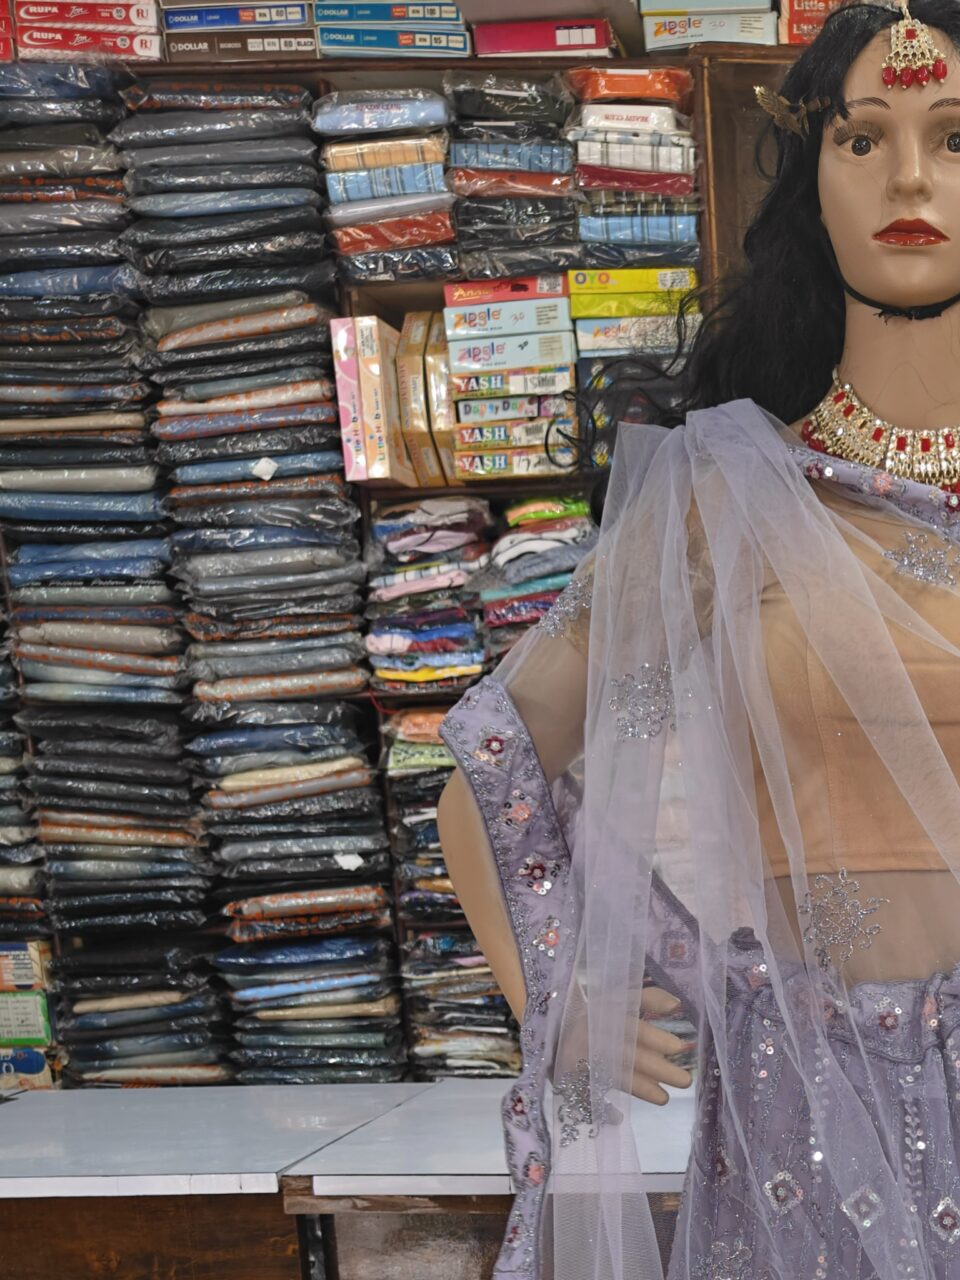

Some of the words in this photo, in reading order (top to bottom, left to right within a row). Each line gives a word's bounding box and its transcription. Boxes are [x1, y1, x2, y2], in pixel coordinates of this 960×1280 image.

[29, 5, 59, 13] RUPA
[32, 31, 63, 40] RUPA
[177, 42, 209, 50] DOLLAR
[574, 271, 610, 284] OYO
[459, 375, 503, 392] YASH
[461, 426, 507, 443] YASH
[461, 454, 507, 472] YASH
